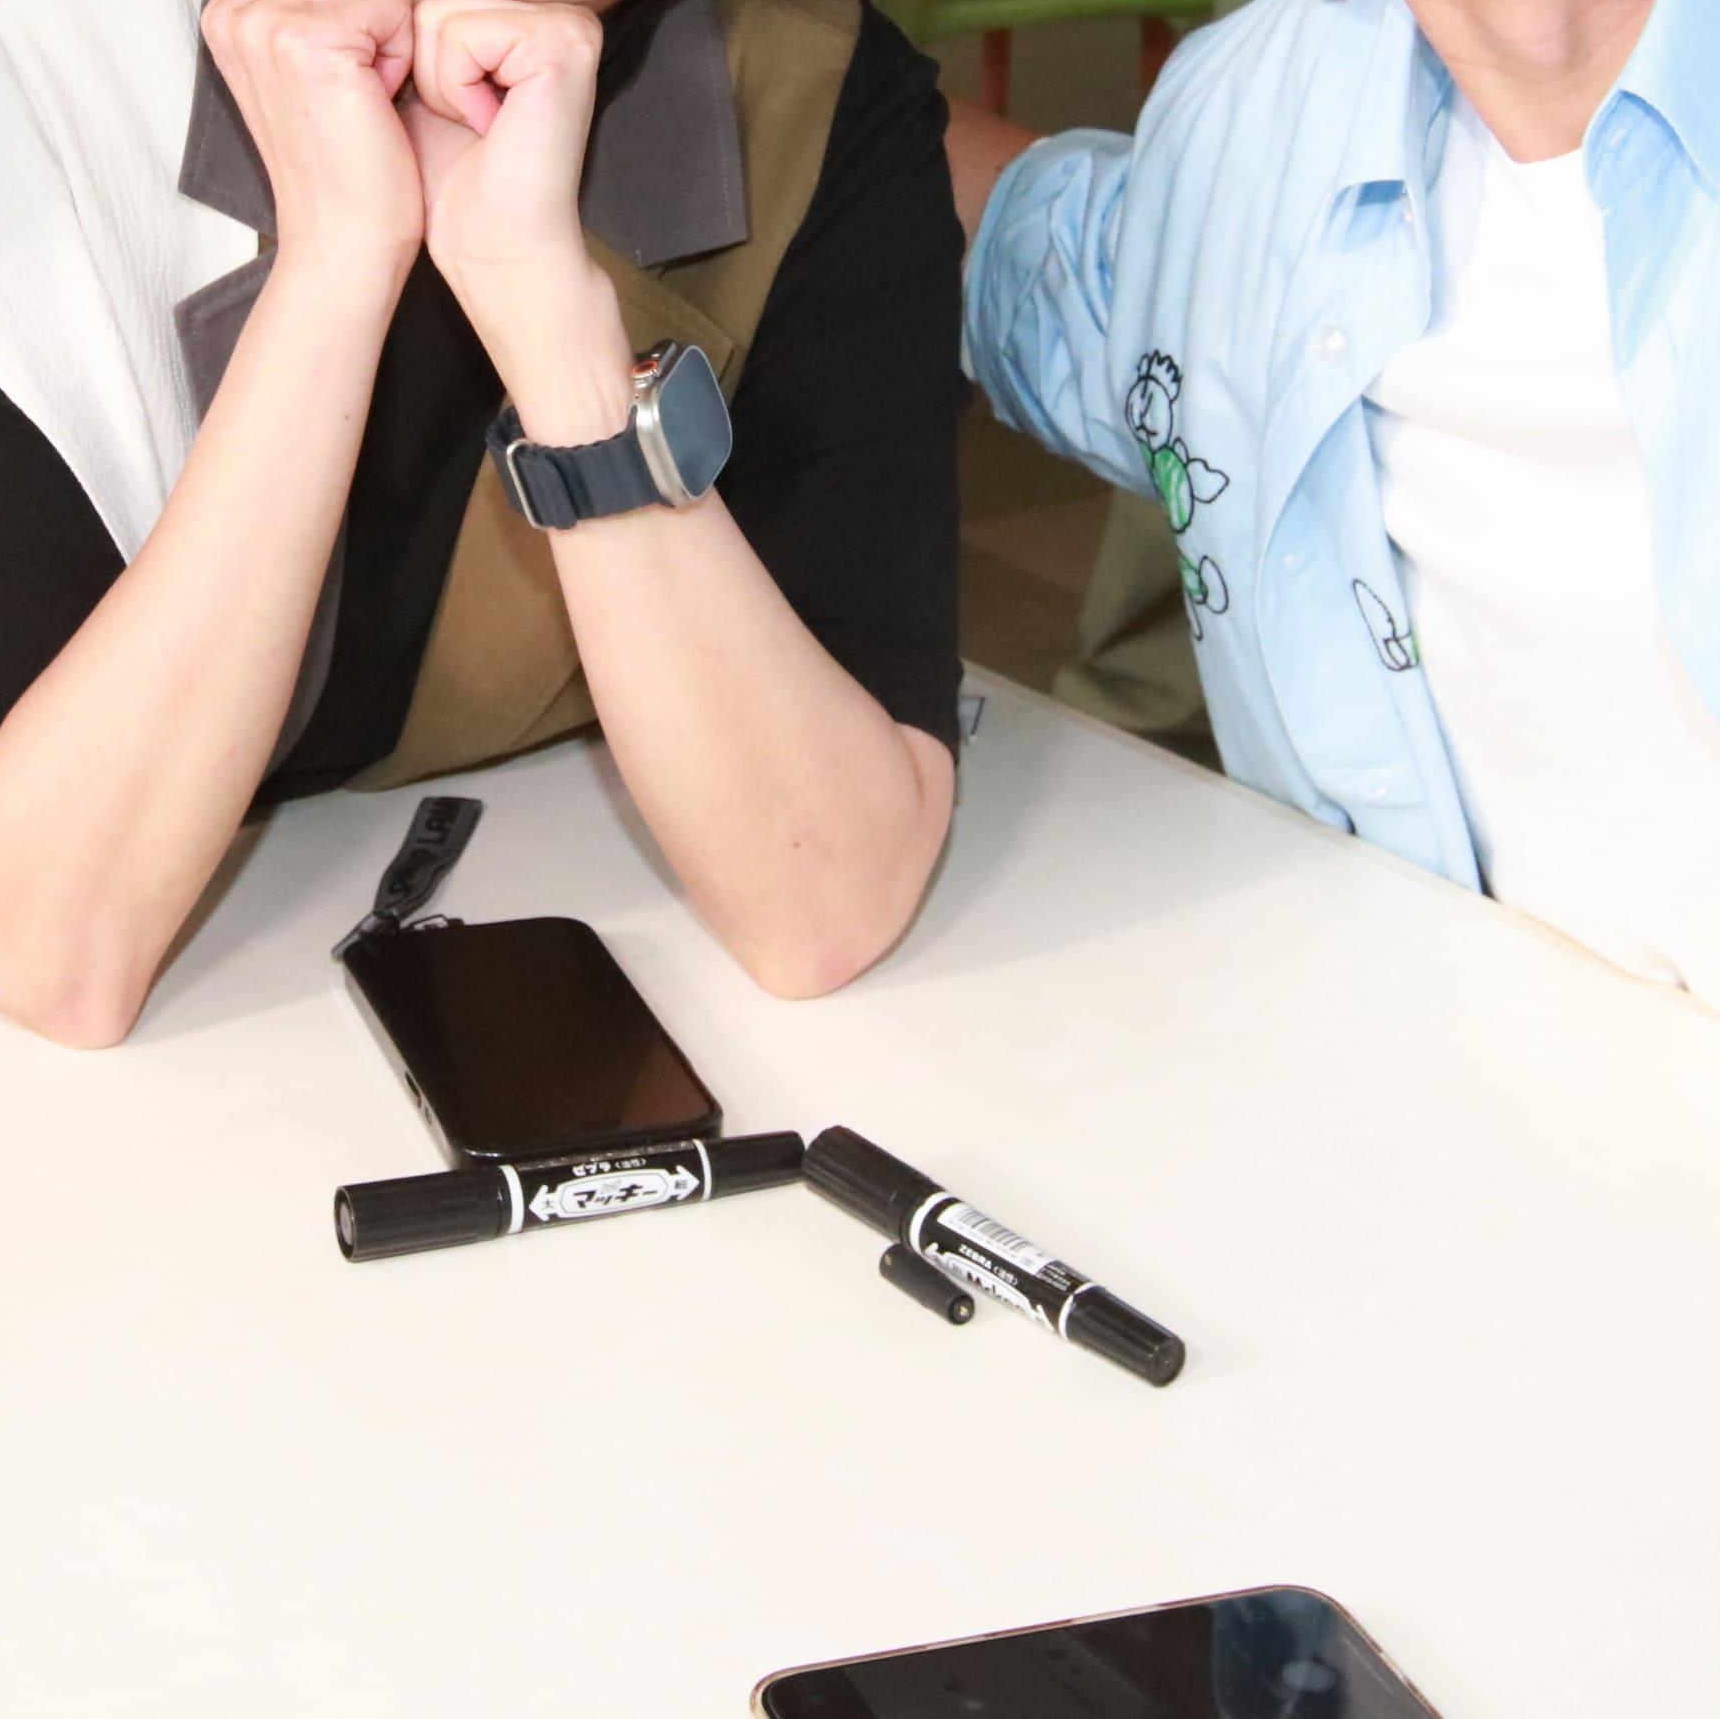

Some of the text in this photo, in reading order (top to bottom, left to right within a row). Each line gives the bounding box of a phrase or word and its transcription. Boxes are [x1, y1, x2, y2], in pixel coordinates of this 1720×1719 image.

[572, 1183, 658, 1209] マッキー
[958, 1243, 993, 1270] ZEBRA
